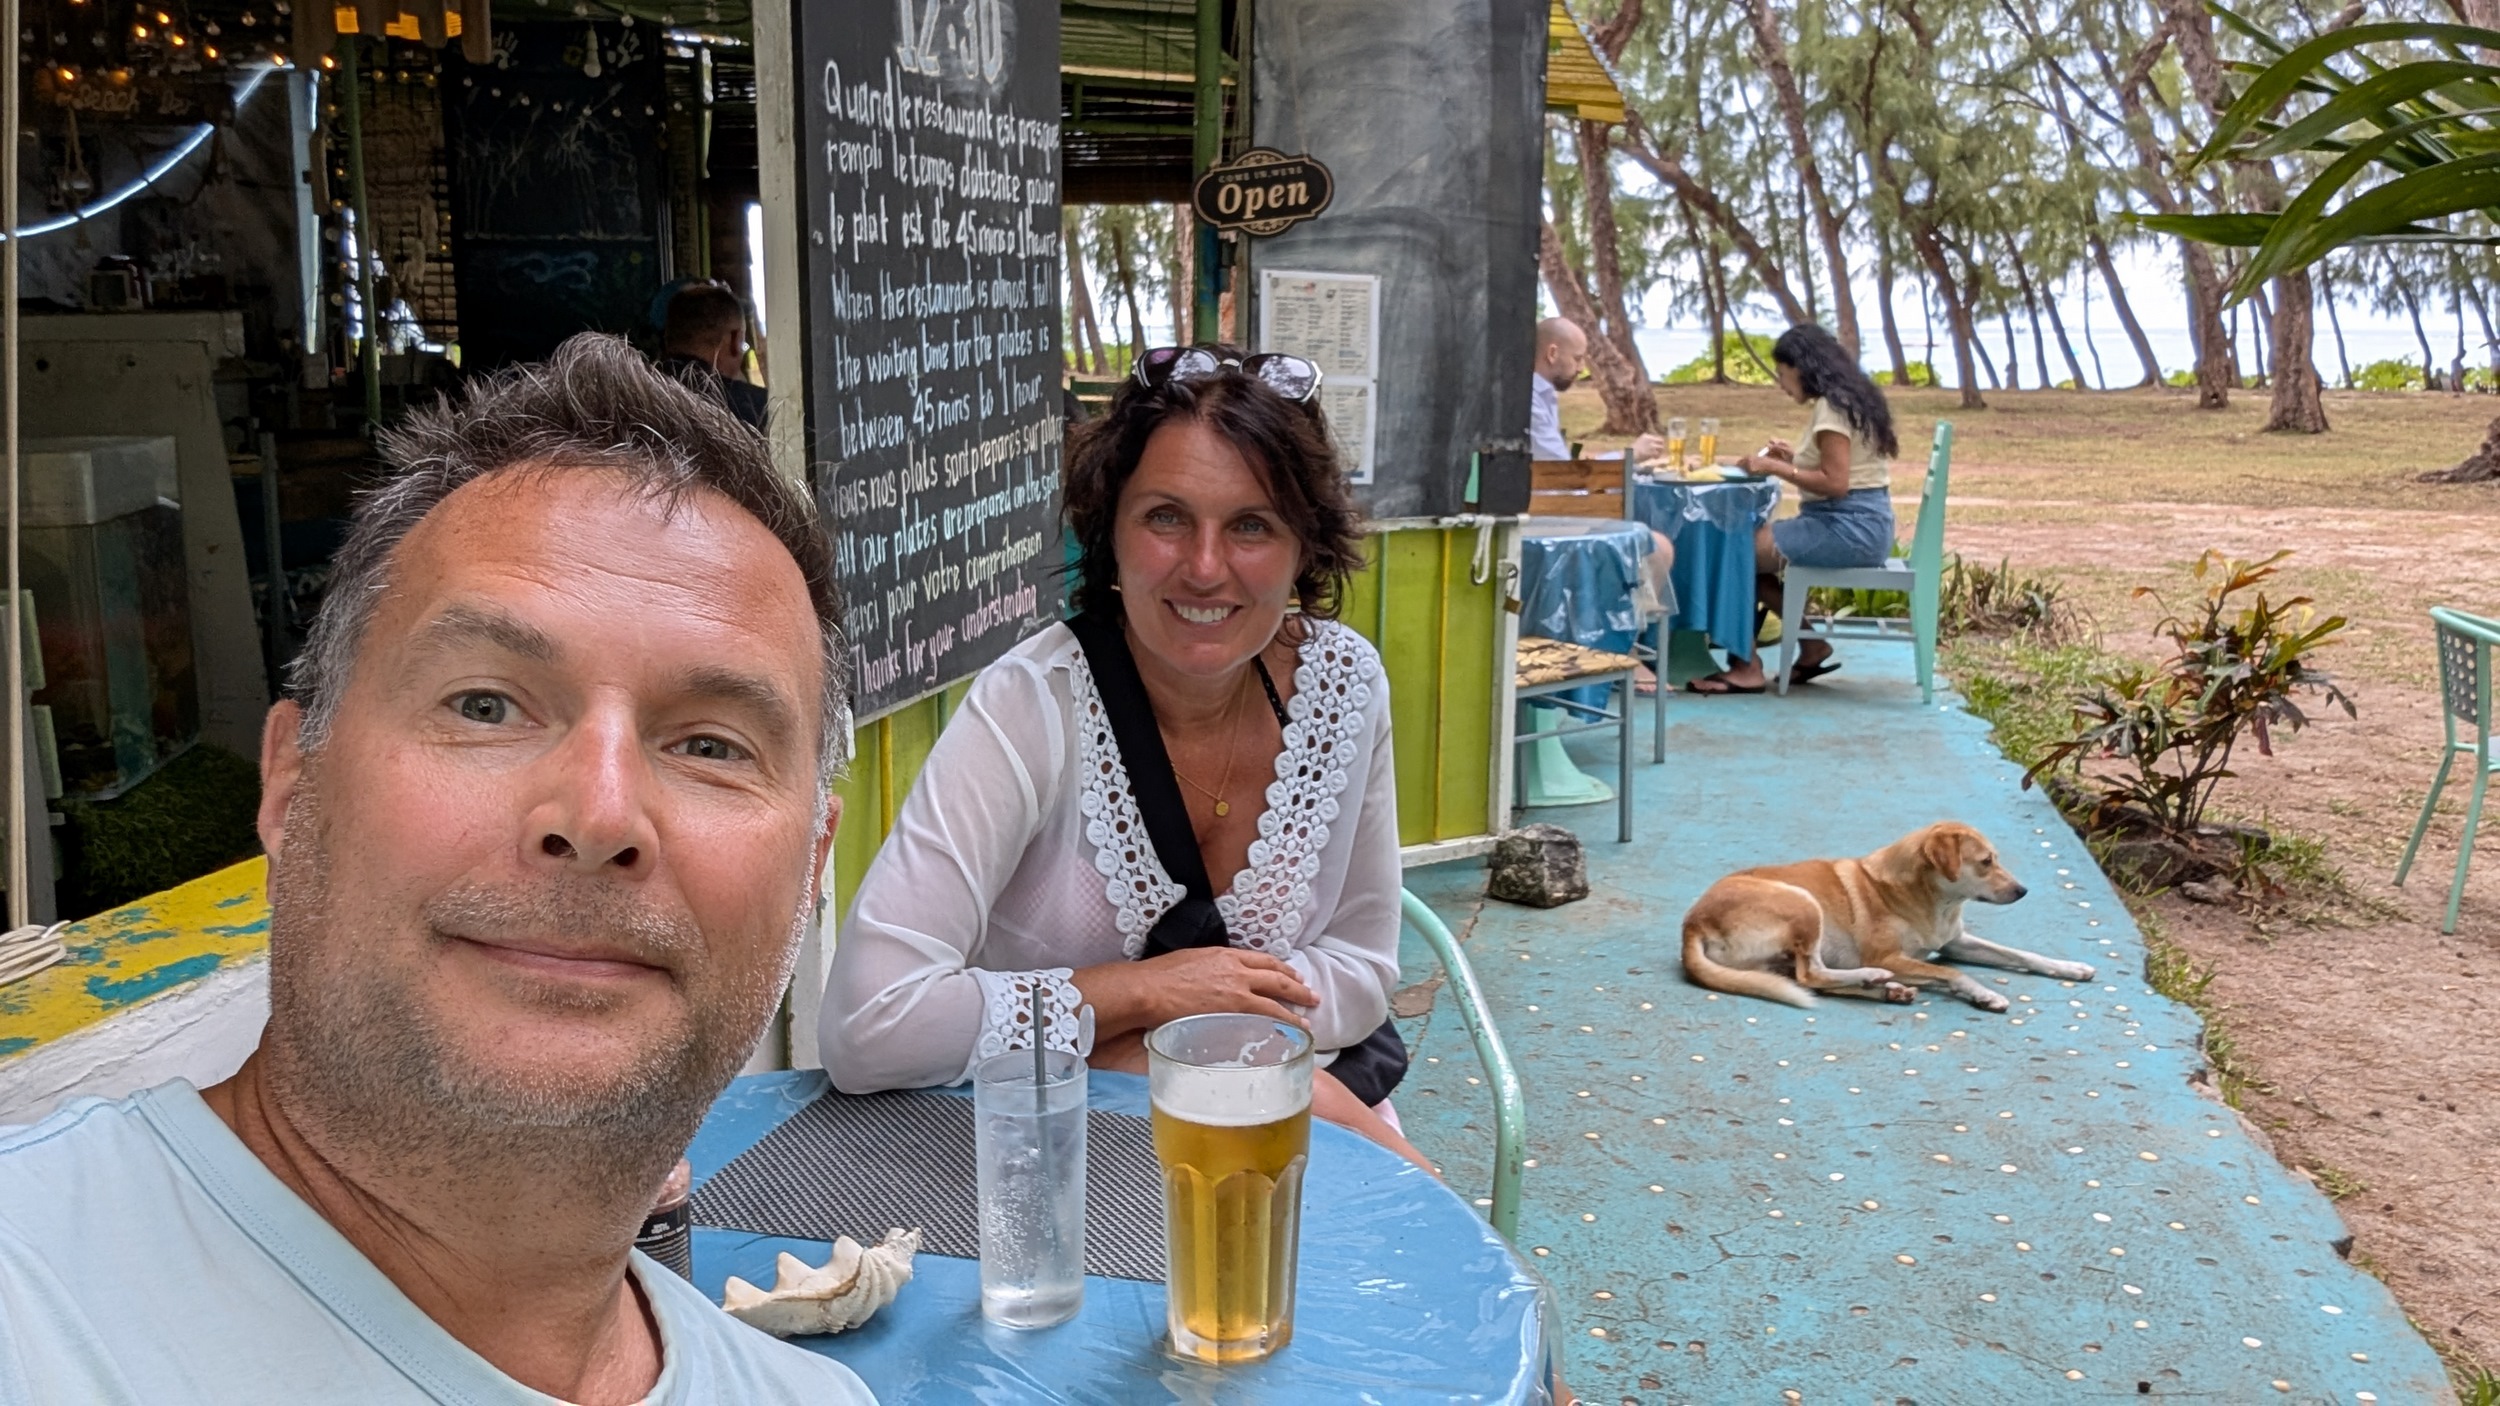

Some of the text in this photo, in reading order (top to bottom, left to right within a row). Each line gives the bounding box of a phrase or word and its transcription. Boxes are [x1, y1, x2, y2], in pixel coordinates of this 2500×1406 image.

[825, 57, 1060, 174] Quand le restaurant est presque
[827, 128, 882, 189] rempli
[892, 133, 908, 184] le
[909, 136, 954, 208] temps
[1026, 178, 1055, 225] pour
[1217, 181, 1310, 219] Open
[830, 192, 844, 254] le
[853, 187, 888, 263] plat
[902, 200, 924, 249] est
[932, 196, 950, 249] de
[832, 267, 873, 325] When
[880, 269, 905, 321] the
[907, 256, 975, 318] restaurant
[976, 264, 988, 308] is
[1032, 262, 1053, 309] full
[835, 312, 1049, 397] the waiting time for the plates is
[840, 396, 905, 460] between
[913, 386, 935, 438] 45
[937, 388, 970, 430] mins
[979, 371, 994, 420] to
[1002, 366, 1009, 416] 1
[835, 530, 856, 580] All
[862, 533, 888, 573] our
[894, 497, 938, 581] plates
[943, 507, 964, 541] are
[964, 462, 1012, 554] prepared
[1025, 455, 1041, 503] the
[1041, 448, 1060, 509] spot
[868, 469, 897, 510] nos
[901, 440, 938, 518] plats
[944, 438, 969, 489] sont
[1023, 422, 1039, 455] sur
[850, 567, 1037, 695] Thanks for your understanding
[887, 579, 918, 642] pour
[923, 549, 960, 602] votre
